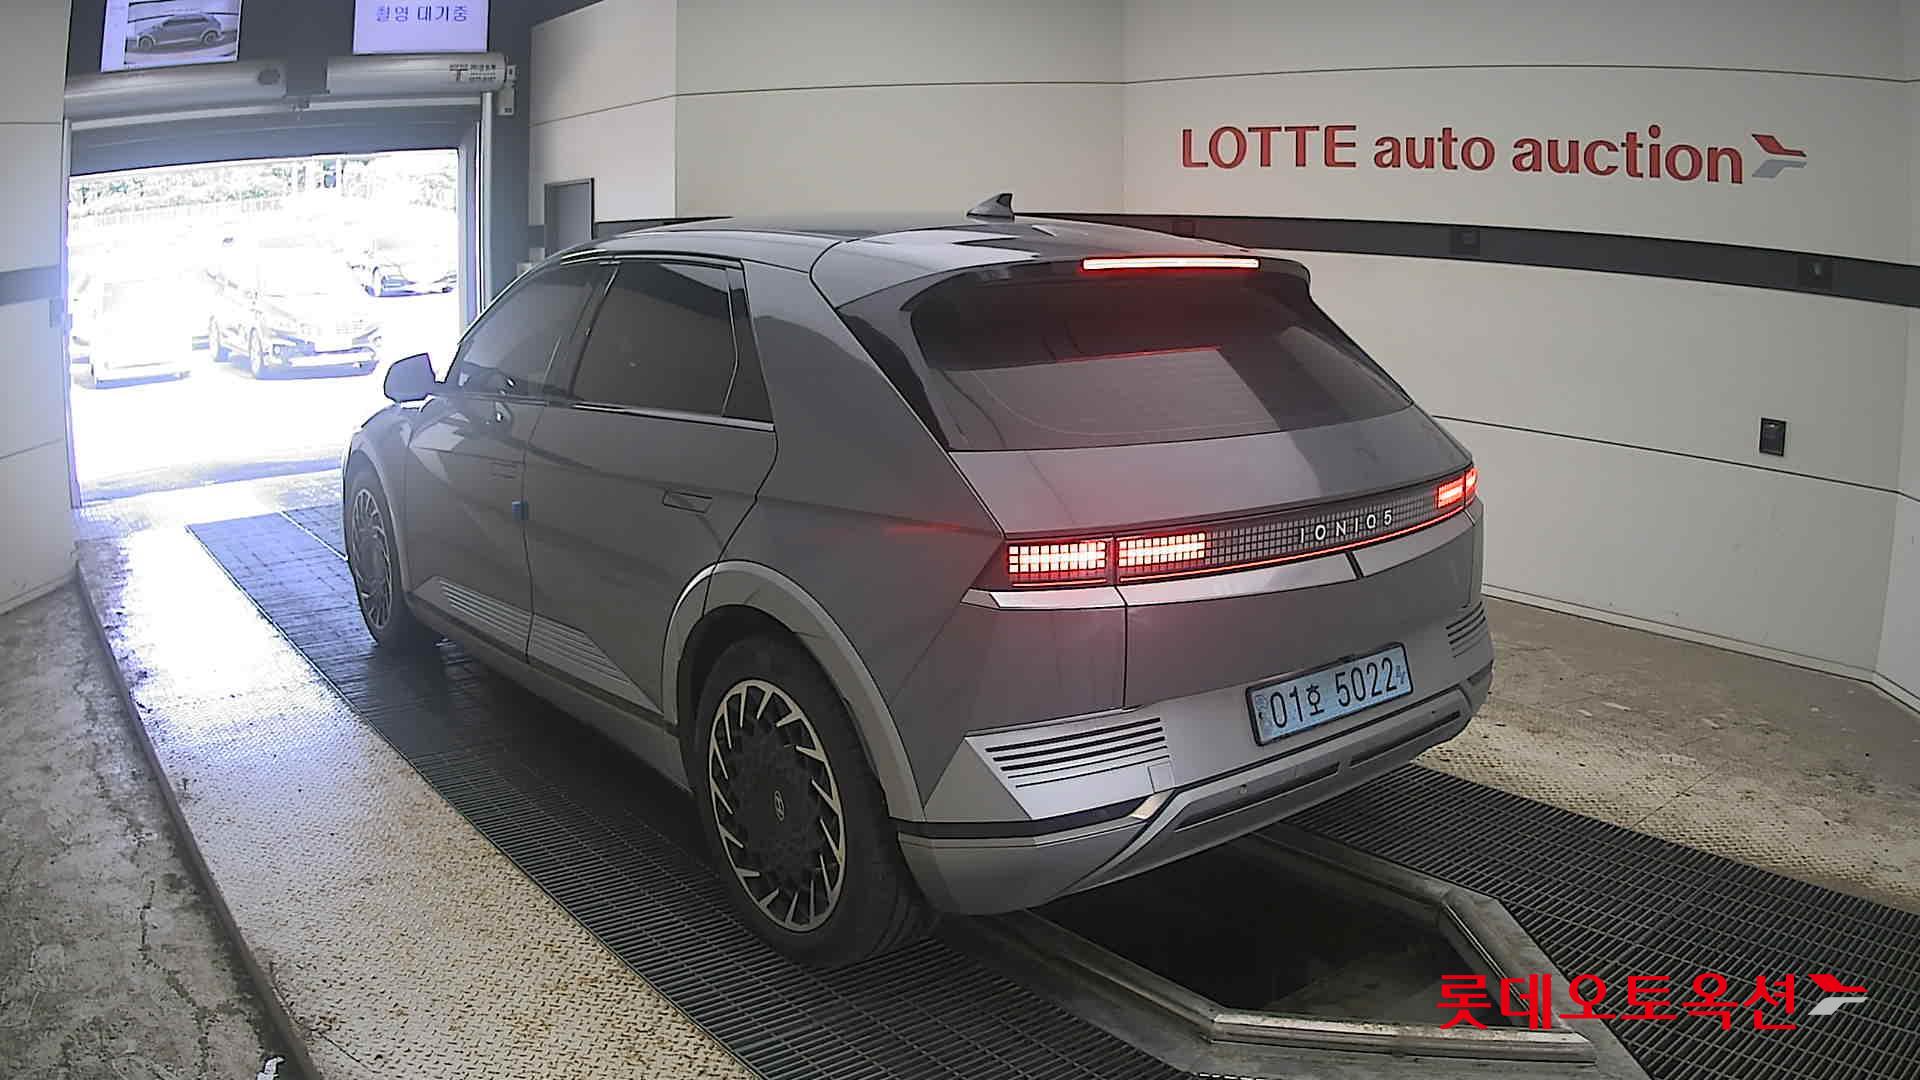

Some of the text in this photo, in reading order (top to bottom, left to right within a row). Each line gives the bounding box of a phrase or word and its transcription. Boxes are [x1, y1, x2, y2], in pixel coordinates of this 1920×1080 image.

[416, 5, 468, 22] 대기중
[1180, 124, 1744, 184] LOTTE auto auction
[1269, 657, 1398, 728] 01호 5022
